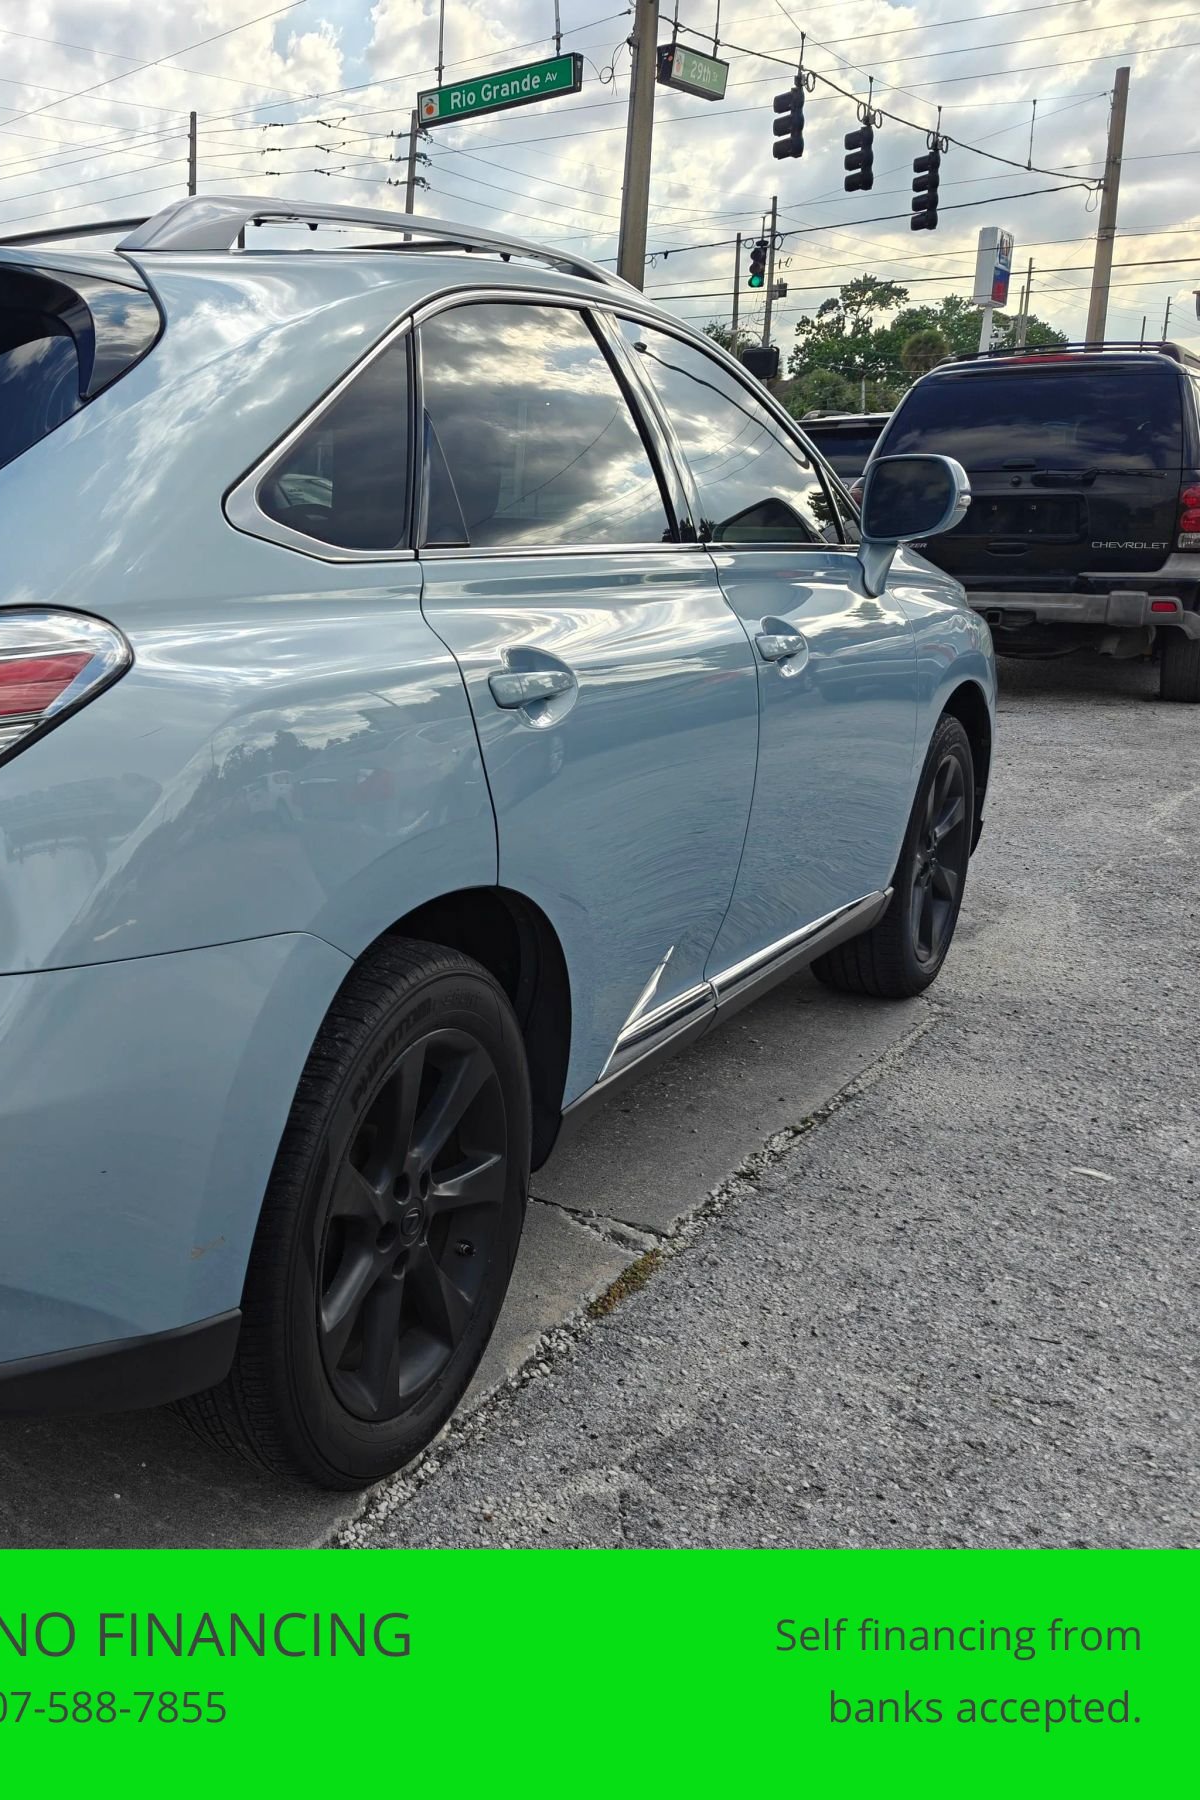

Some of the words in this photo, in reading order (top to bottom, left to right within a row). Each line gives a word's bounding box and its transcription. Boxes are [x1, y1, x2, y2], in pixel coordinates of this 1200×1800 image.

[690, 60, 711, 84] 29th
[450, 90, 476, 110] Rio
[481, 73, 541, 102] Grande
[544, 71, 558, 83] Av
[1091, 541, 1169, 549] CHEVROLET
